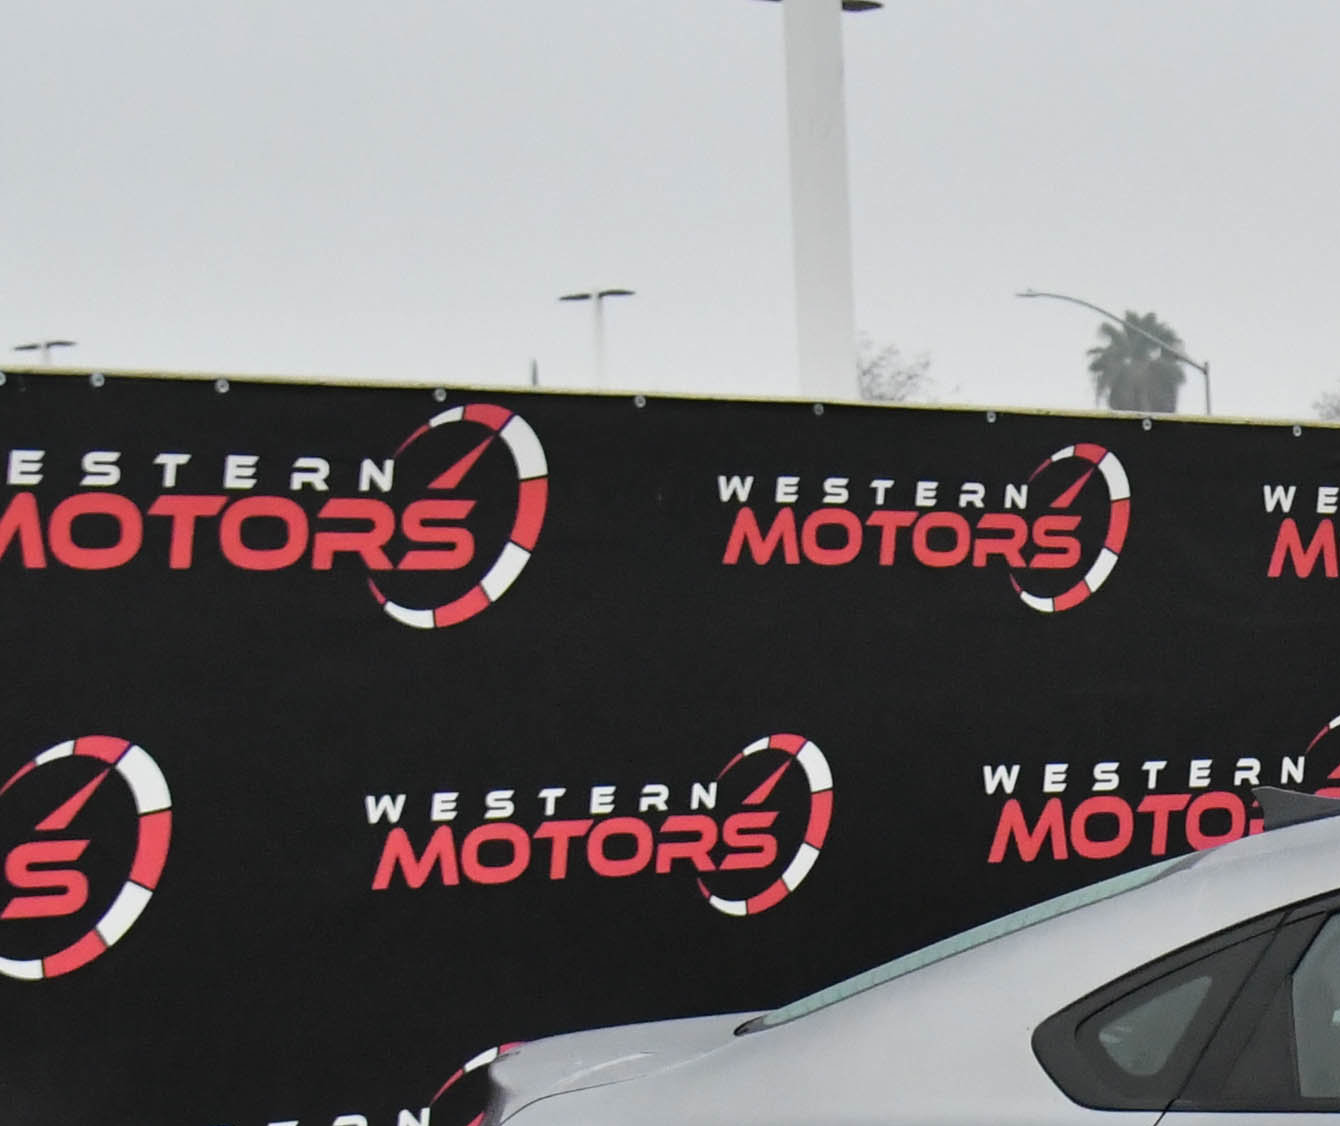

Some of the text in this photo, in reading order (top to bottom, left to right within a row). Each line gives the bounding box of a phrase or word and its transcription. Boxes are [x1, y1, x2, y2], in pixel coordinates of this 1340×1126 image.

[717, 475, 1028, 510] WESTERN
[722, 506, 1082, 569] MOTORS
[983, 755, 1305, 795] WESTERN
[365, 781, 718, 824] WESTERN
[372, 811, 779, 890] MOTORS
